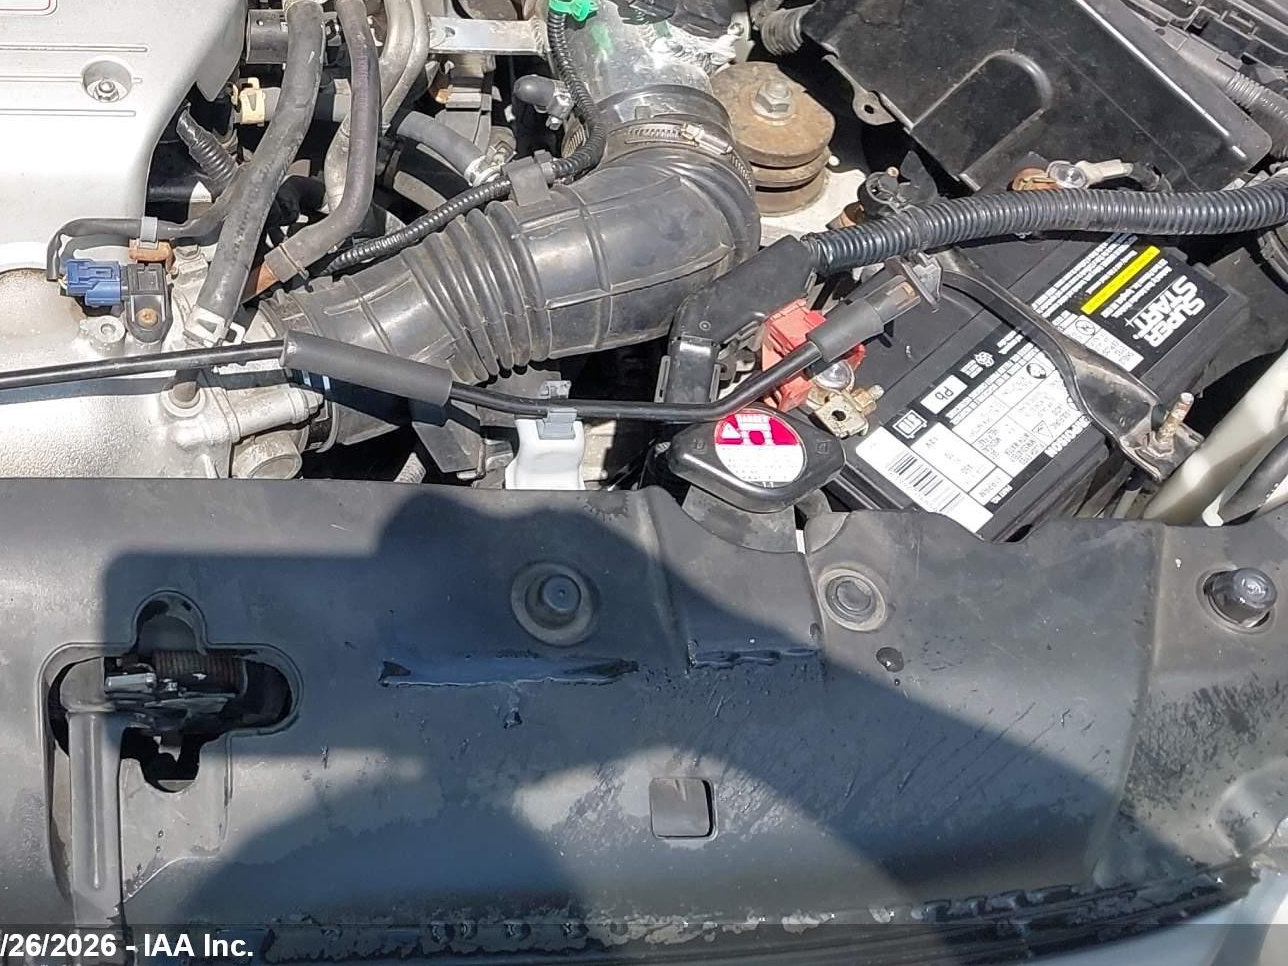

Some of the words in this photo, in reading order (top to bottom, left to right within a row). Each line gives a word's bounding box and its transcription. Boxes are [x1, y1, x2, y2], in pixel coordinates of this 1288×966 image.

[1131, 274, 1196, 340] START
[1148, 297, 1206, 348] SUPER
[932, 384, 955, 404] Pb
